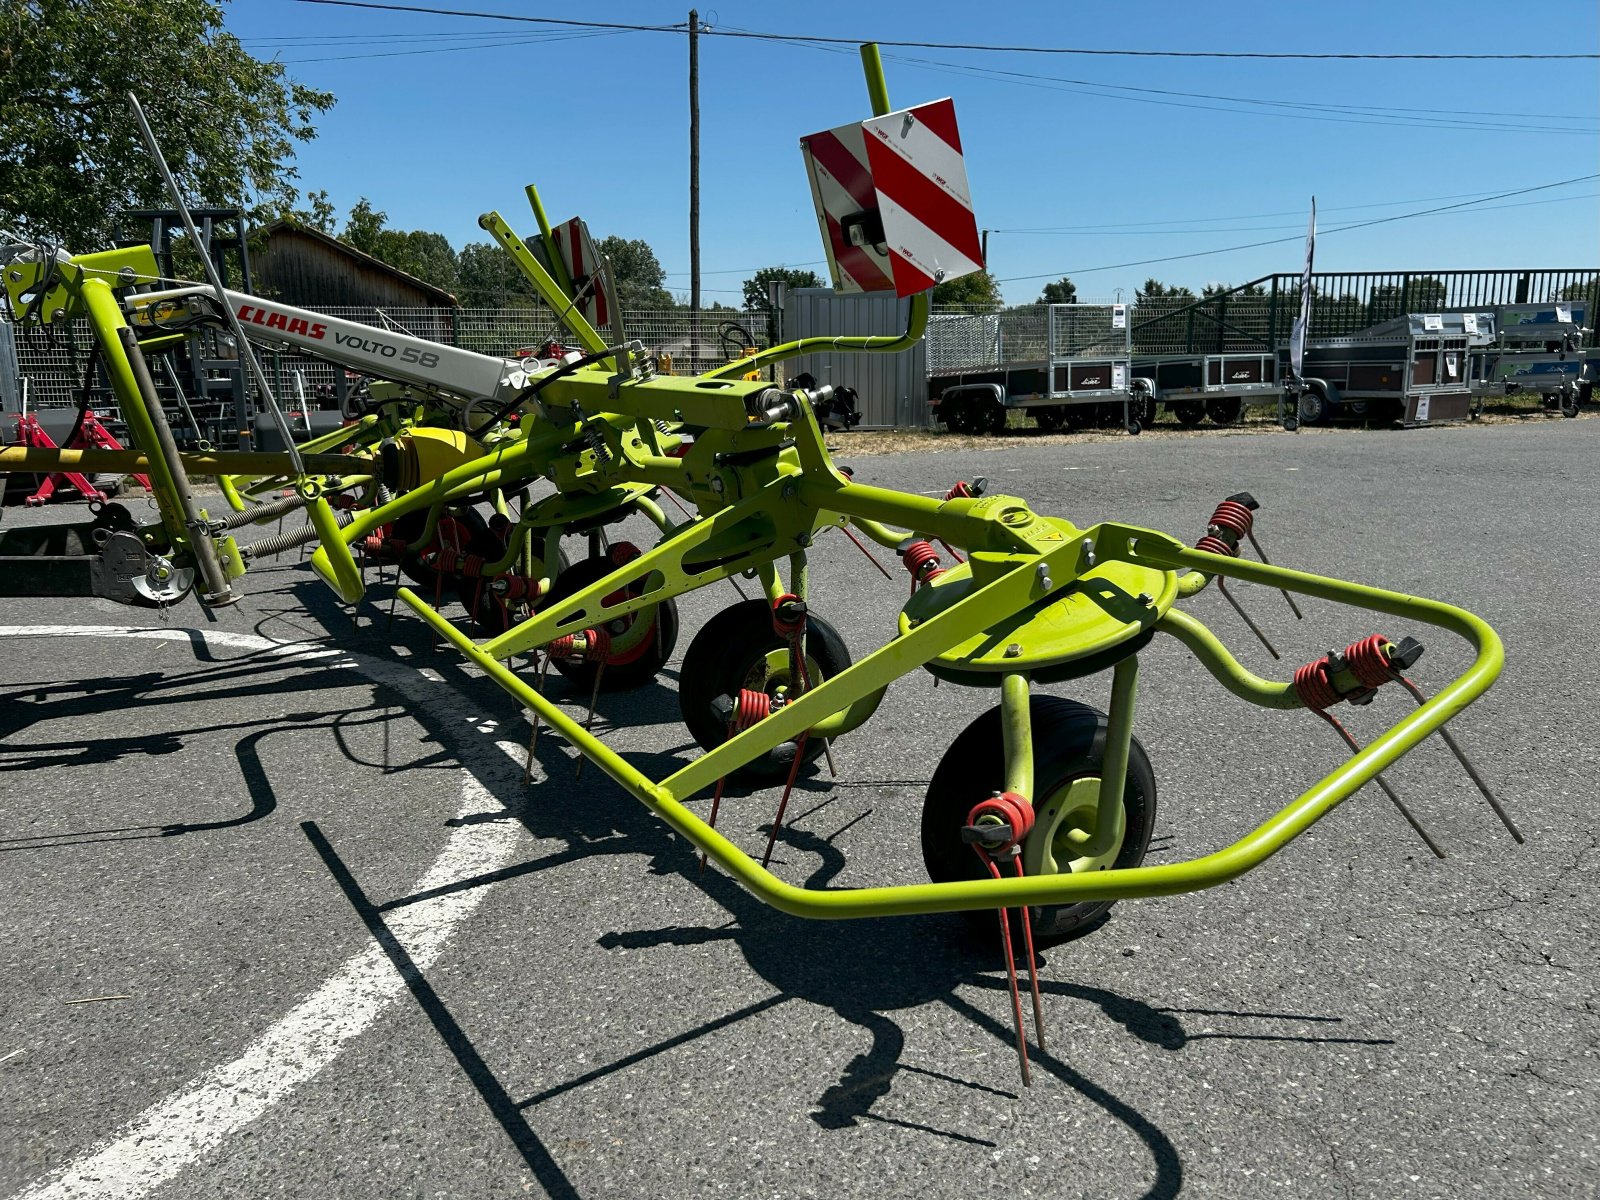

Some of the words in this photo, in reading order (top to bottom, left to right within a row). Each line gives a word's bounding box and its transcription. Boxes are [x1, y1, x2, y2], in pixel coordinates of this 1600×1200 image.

[237, 305, 328, 340] CLAAS
[335, 332, 397, 358] VOLTO
[400, 347, 440, 369] 58
